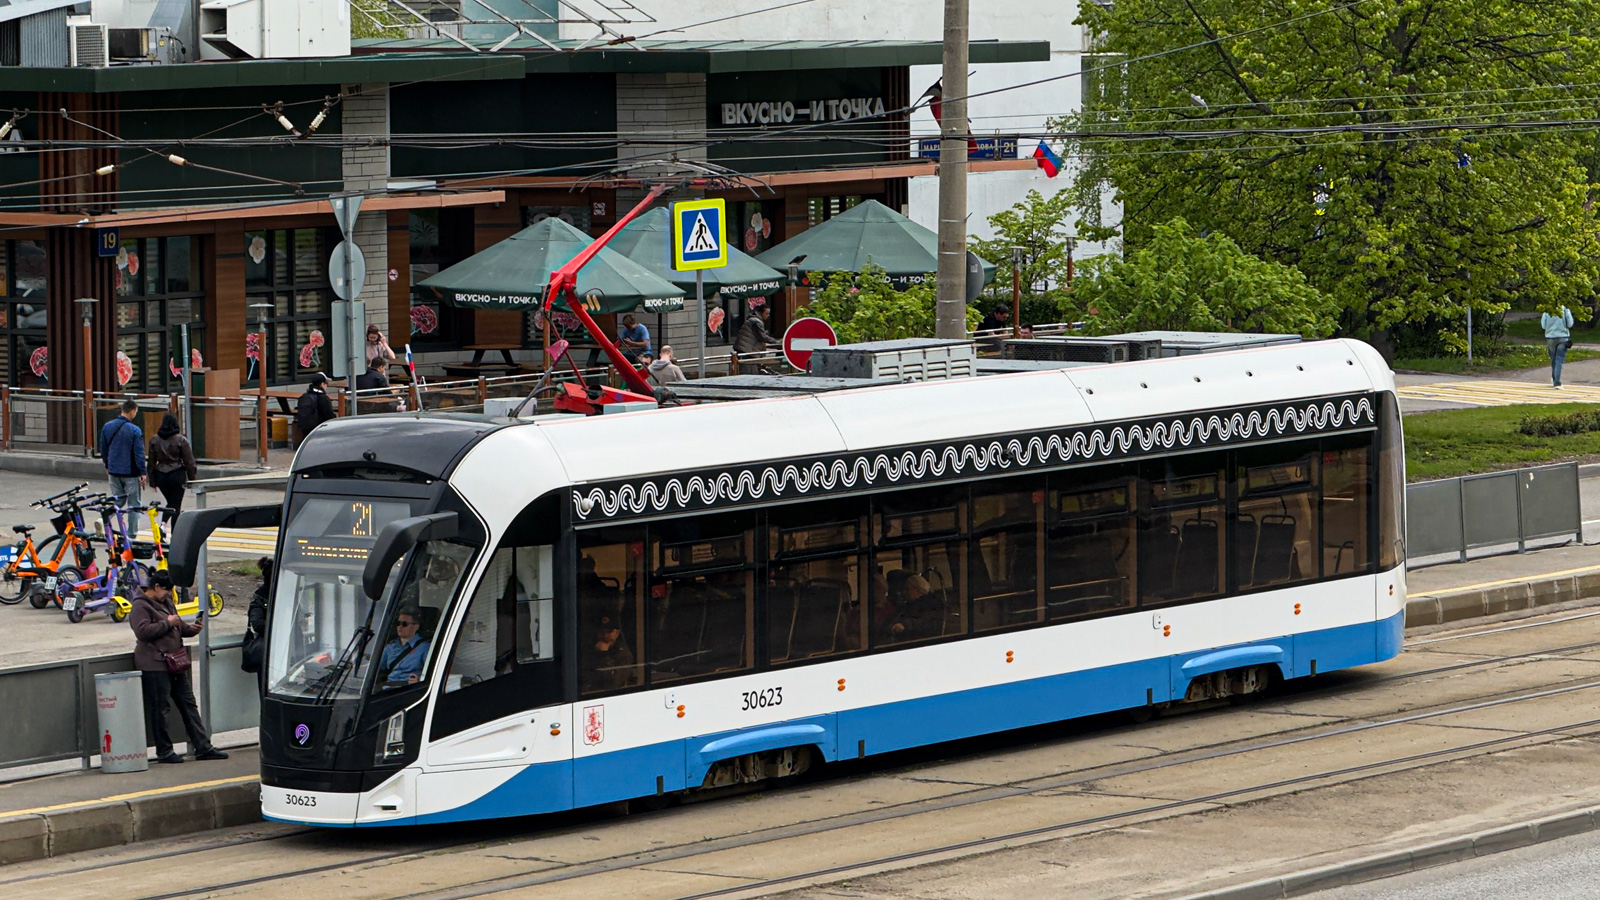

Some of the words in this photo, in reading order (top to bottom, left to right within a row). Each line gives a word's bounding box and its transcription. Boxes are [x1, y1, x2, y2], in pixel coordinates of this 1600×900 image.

[826, 97, 886, 121] ТОЧКА
[1003, 142, 1014, 153] 21
[103, 232, 116, 249] 19
[759, 281, 780, 290] ТОЧКА
[508, 296, 538, 305] ТОЧКА
[352, 501, 372, 536] 21
[742, 686, 783, 711] 30623
[285, 793, 317, 807] 30623
